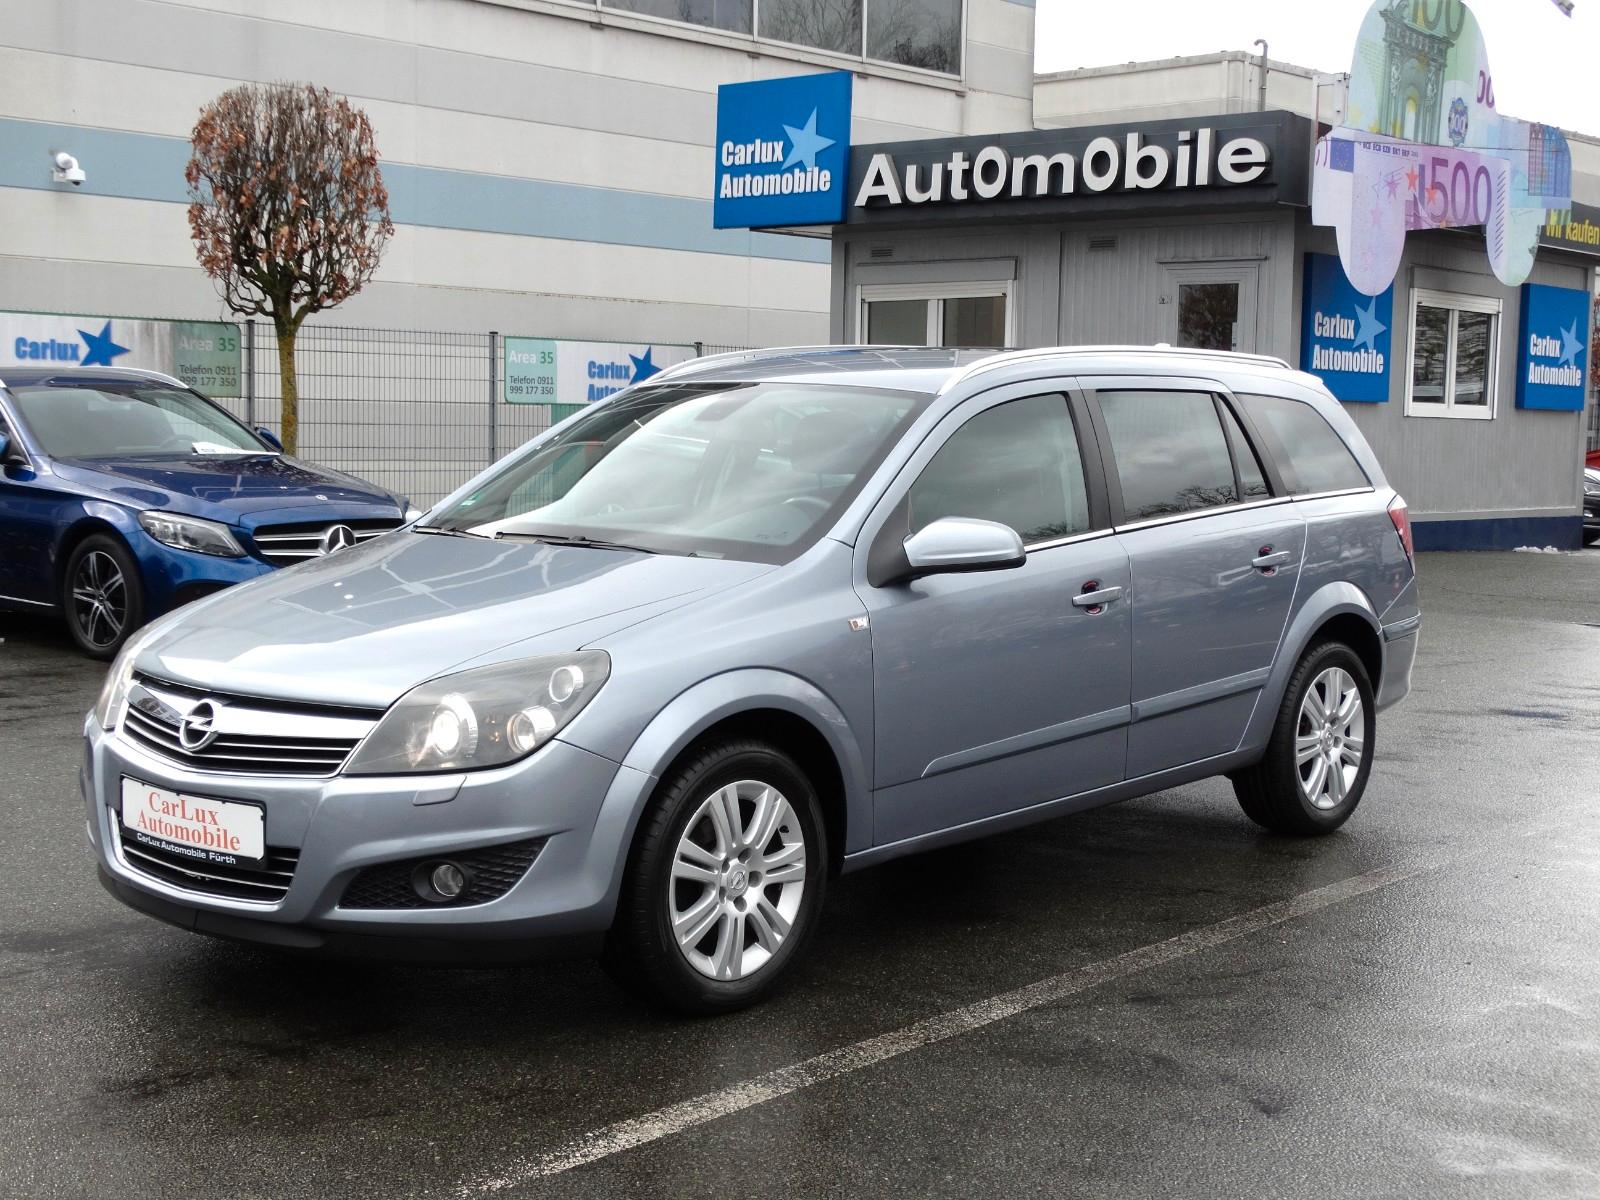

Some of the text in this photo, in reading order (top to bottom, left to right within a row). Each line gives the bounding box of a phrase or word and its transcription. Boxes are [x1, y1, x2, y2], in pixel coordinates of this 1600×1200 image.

[721, 138, 784, 167] Carlux
[719, 166, 831, 199] Automobile
[1314, 311, 1355, 341] Carlux
[15, 336, 80, 362] Carlux
[218, 337, 236, 352] 35
[1530, 333, 1561, 358] Carlux
[179, 364, 236, 376] Telefon 0911
[508, 350, 554, 365] Area 35
[588, 360, 630, 380] Carlux
[1312, 344, 1384, 374] Automobile
[201, 377, 216, 387] 177
[220, 377, 237, 388] 350
[509, 375, 554, 385] Telefon 0911
[1528, 365, 1581, 387] Automobile
[509, 385, 554, 395] 999 177 350
[149, 792, 219, 825] CarLux
[137, 810, 240, 851] Automobile
[137, 832, 236, 865] CarLux Automobile Fürth
